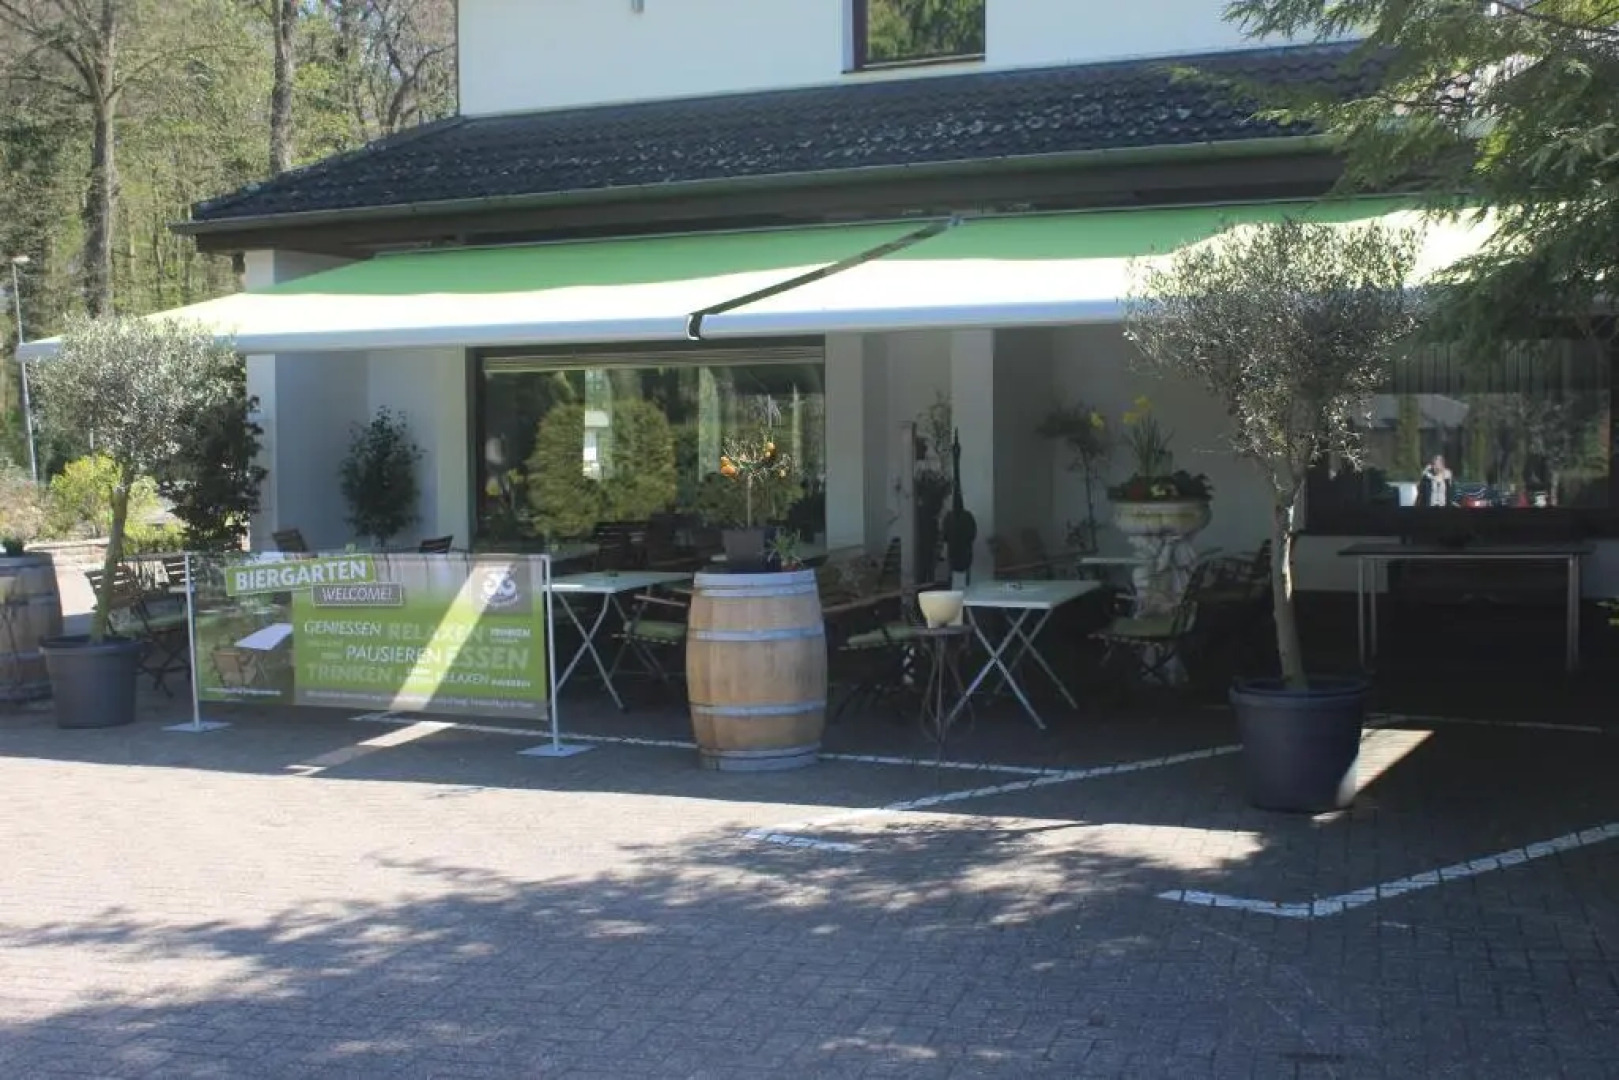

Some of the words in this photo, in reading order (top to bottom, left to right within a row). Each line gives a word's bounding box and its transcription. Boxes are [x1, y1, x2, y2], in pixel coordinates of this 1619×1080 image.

[235, 560, 366, 590] BIERGARTEN
[322, 587, 393, 602] WELCOME!
[304, 620, 381, 636] GENIESSEN
[387, 623, 483, 641] RELAXEN
[346, 645, 440, 663] PAUSIEREN
[446, 646, 529, 670] ESSEN
[306, 664, 391, 684] TRINKEN
